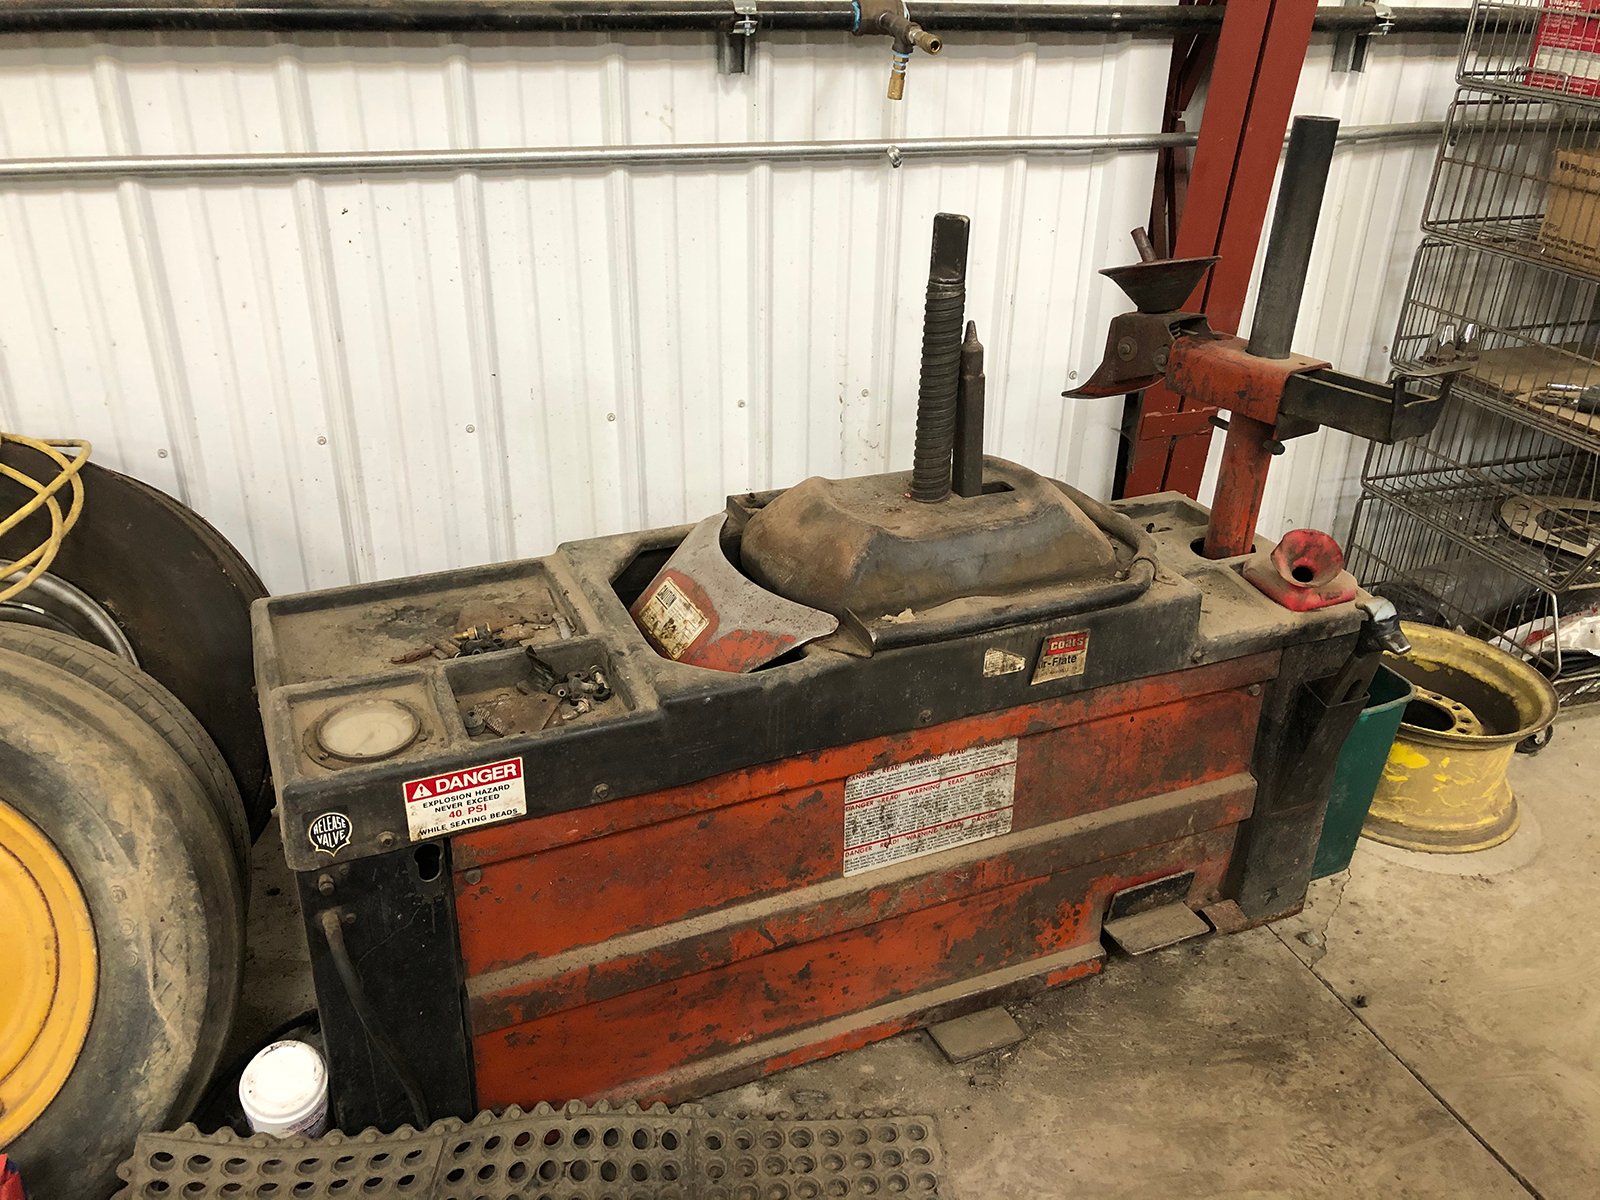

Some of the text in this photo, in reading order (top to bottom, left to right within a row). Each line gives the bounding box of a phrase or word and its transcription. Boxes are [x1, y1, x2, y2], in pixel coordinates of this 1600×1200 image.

[435, 763, 517, 793] DANGER
[847, 770, 875, 783] DANGER
[909, 755, 942, 767] WARNING
[423, 784, 510, 808] EXPLOSION HAZARD
[845, 768, 1001, 812] DANGER READ! WARNING READ! DANGER
[434, 794, 500, 813] NEVER EXCEED
[449, 803, 487, 819] 40 PSI
[313, 816, 347, 835] RELEASE
[420, 808, 518, 836] WHILE SEATING BEADS
[316, 830, 346, 848] VALVE
[845, 846, 873, 858] DANGER
[906, 828, 939, 841] WARNING
[971, 813, 998, 824] DANGER
